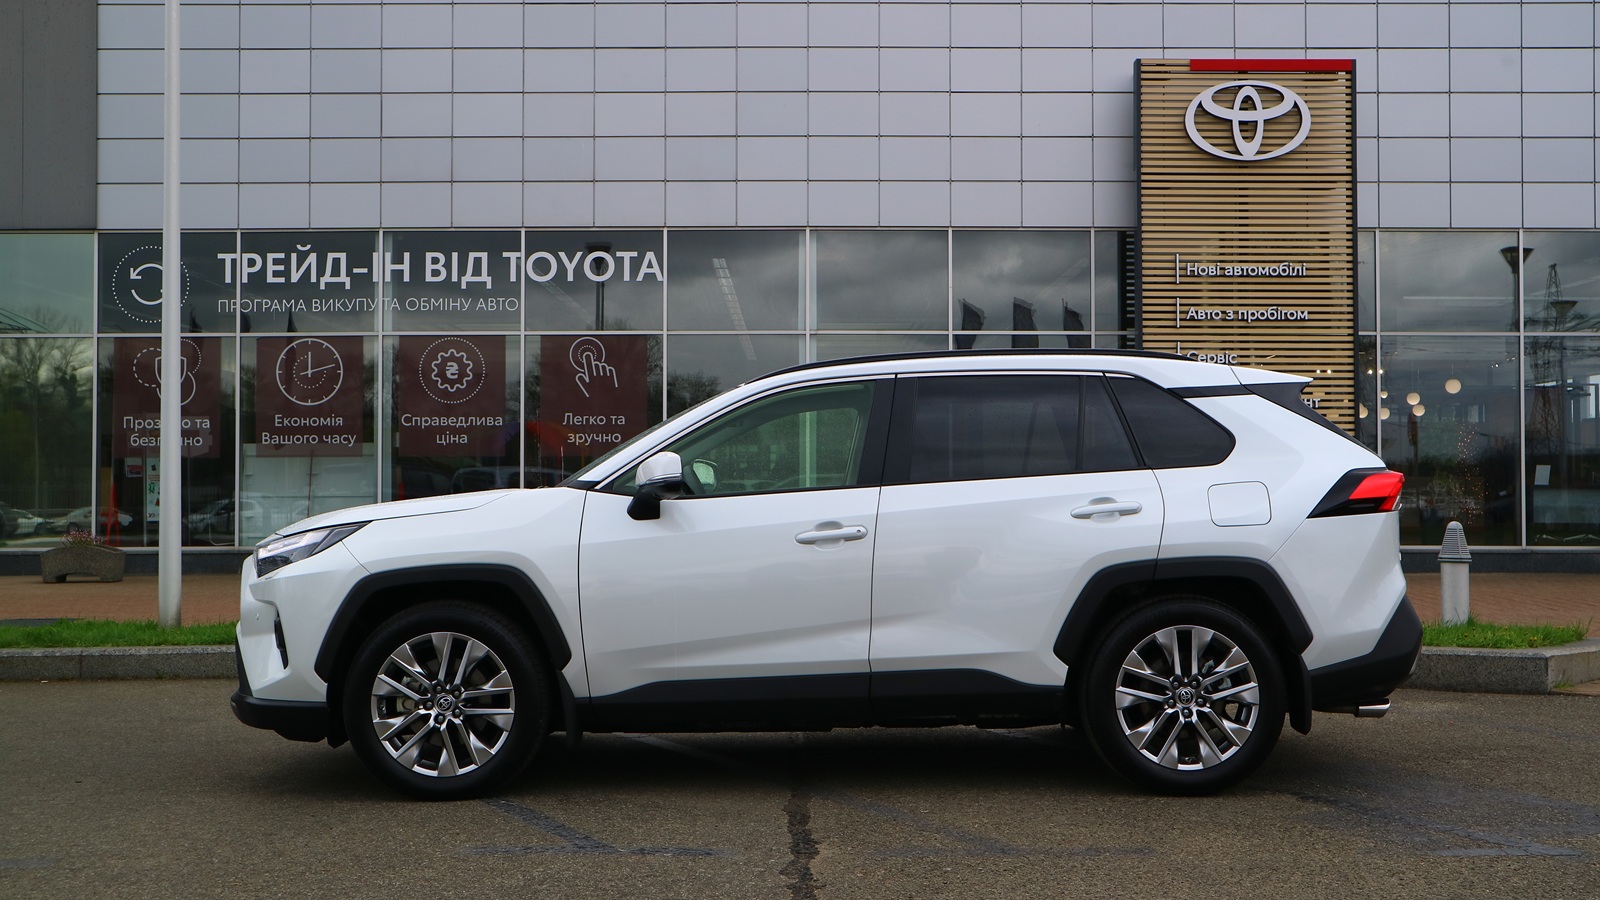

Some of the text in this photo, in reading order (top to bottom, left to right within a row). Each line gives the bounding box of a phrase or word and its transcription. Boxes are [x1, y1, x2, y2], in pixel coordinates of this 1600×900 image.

[217, 244, 664, 290] ТРЕЙД-ІН ВІД TOYOTA
[1186, 262, 1307, 277] Нові автомобілі
[218, 297, 519, 312] ПРОГРАМА ВИКУПУ ТА ОБМІНУ АВТО
[1186, 306, 1309, 324] Авто з пробігом
[123, 416, 210, 432] Прозо та
[274, 414, 343, 427] Економія
[401, 414, 503, 429] Справедлива
[562, 413, 626, 426] Легко та
[130, 433, 203, 447] безно
[262, 432, 357, 448] Вашого часу
[436, 431, 468, 446] ціна
[567, 432, 622, 446] зручно
